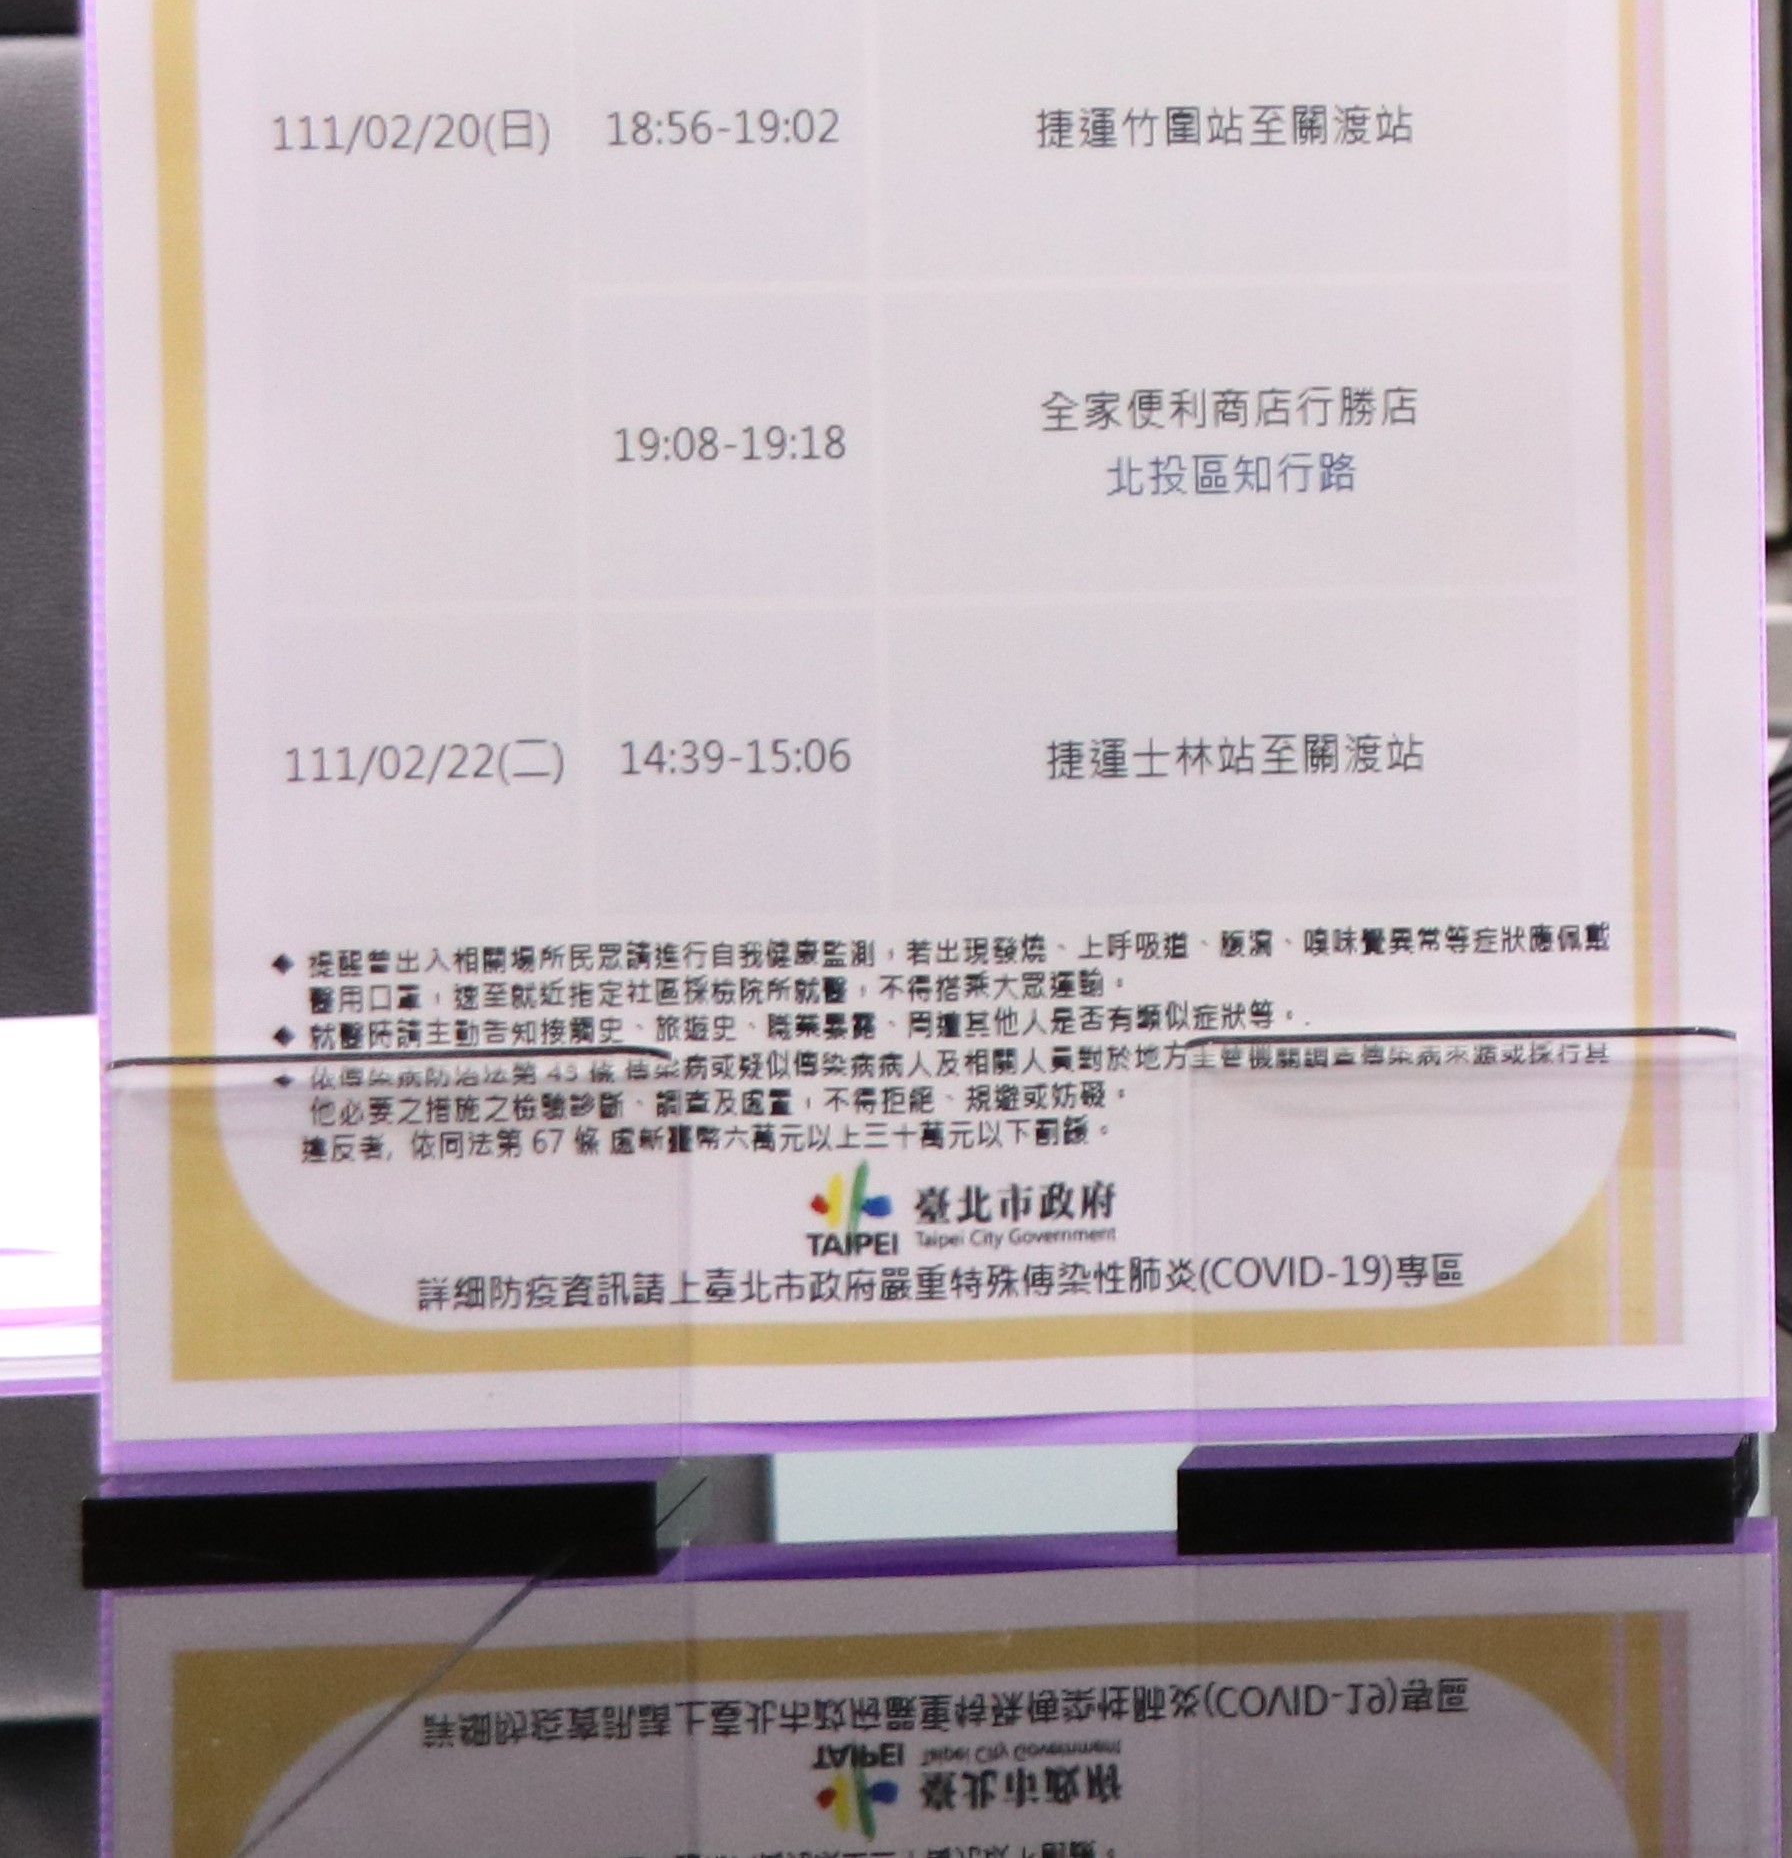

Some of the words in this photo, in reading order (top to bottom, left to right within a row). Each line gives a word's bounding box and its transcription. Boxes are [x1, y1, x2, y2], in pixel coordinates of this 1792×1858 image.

[273, 109, 551, 157] 111/02/20(日)
[607, 108, 840, 147] 18:56-19:02
[1036, 104, 1413, 150] 捷運竹圍站至關渡站
[1040, 386, 1419, 432] 全家便利商店行勝店
[614, 424, 847, 464] 19:08-19:18
[1106, 451, 1358, 497] 北投區知行路
[283, 738, 566, 787] 111/02/22(二)
[620, 737, 852, 776] 14:39-15:06
[1046, 732, 1425, 782] 捷運士林站至關渡站
[915, 1179, 1116, 1226] 臺北市政府
[806, 1231, 899, 1257] TAIPEI
[915, 1230, 965, 1249] Taipei
[969, 1229, 1004, 1250] City
[1008, 1226, 1117, 1245] Government
